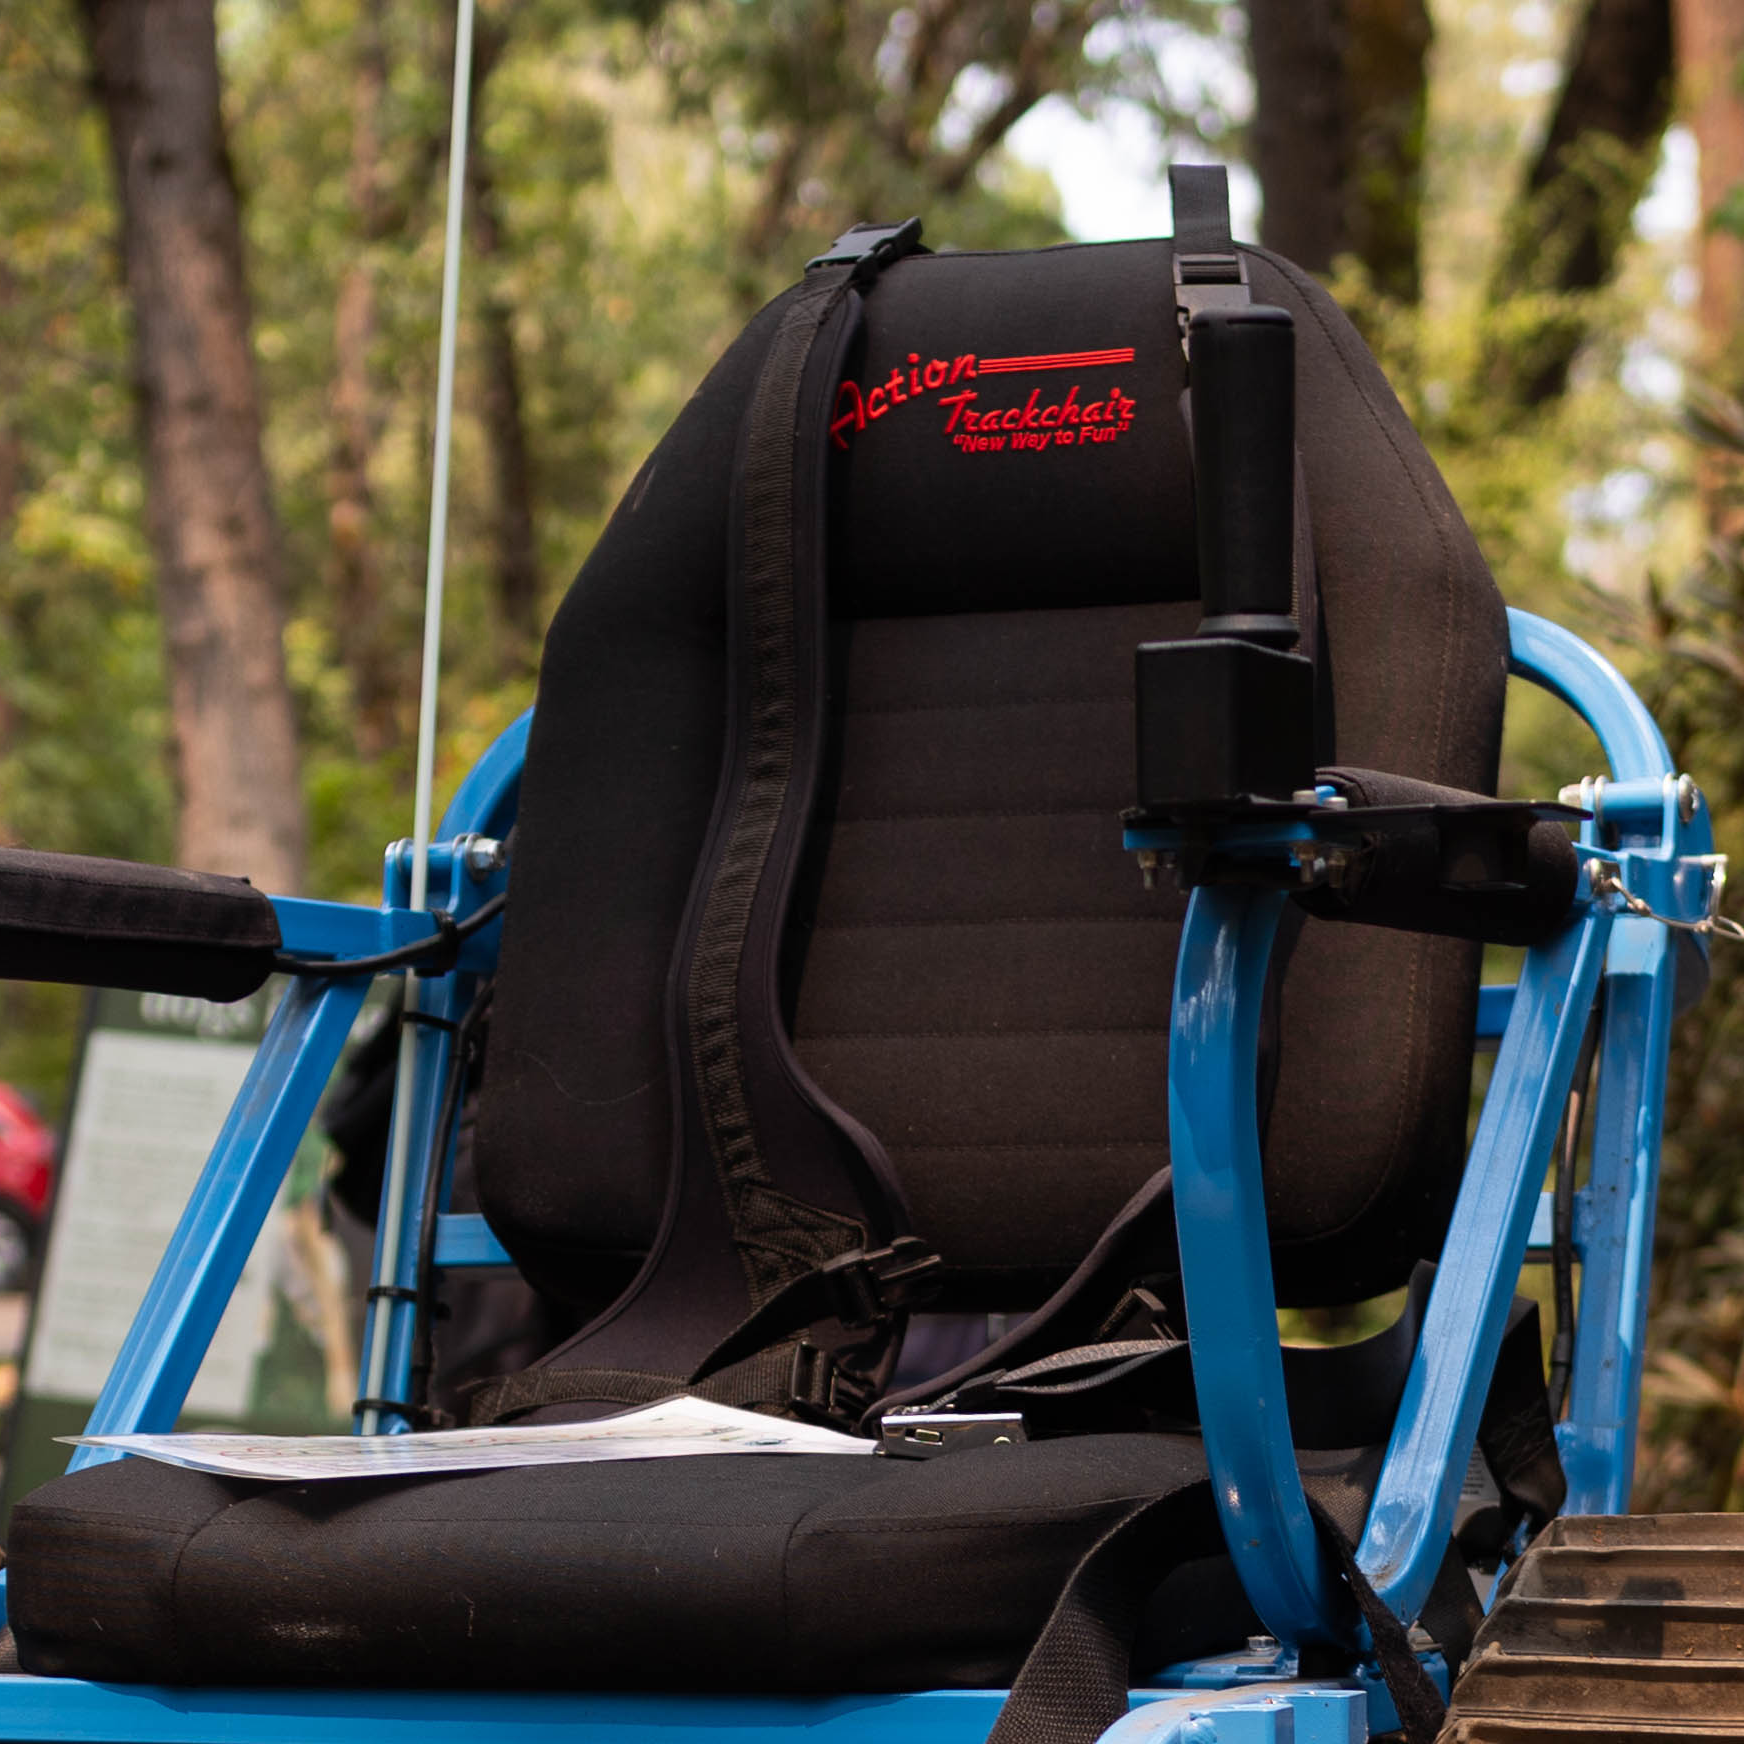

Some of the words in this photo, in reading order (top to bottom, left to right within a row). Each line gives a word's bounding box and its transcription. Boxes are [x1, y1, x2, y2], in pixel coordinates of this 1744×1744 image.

[829, 352, 978, 450] Action
[937, 385, 1137, 435] Trackchair
[1010, 431, 1052, 452] Way
[1054, 428, 1075, 446] to
